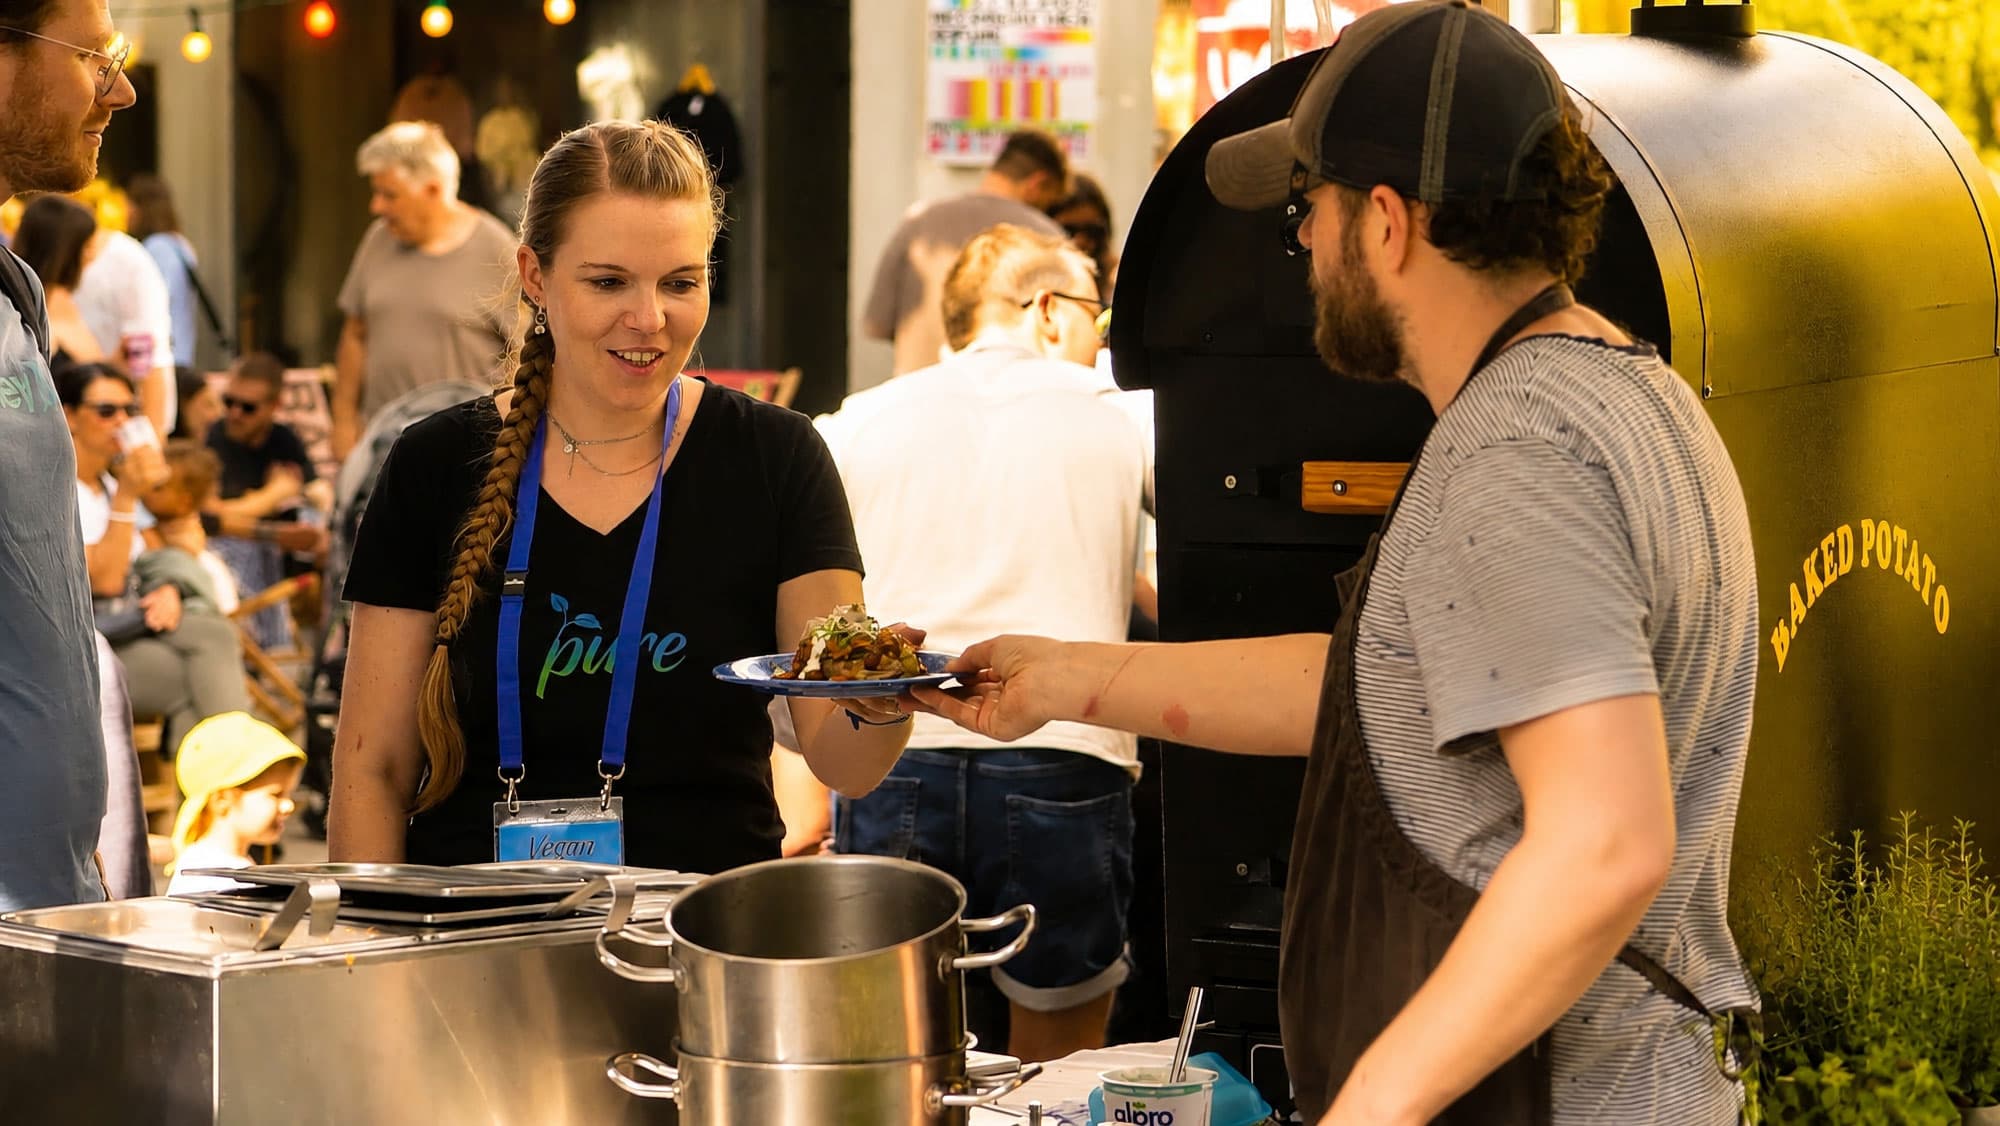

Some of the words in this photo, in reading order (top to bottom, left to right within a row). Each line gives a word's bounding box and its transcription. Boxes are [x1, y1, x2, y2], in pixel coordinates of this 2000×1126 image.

[1770, 523, 1854, 673] BAKED
[1861, 518, 1950, 634] POTATO
[529, 834, 595, 860] Vegan
[1114, 1101, 1174, 1126] alpro
